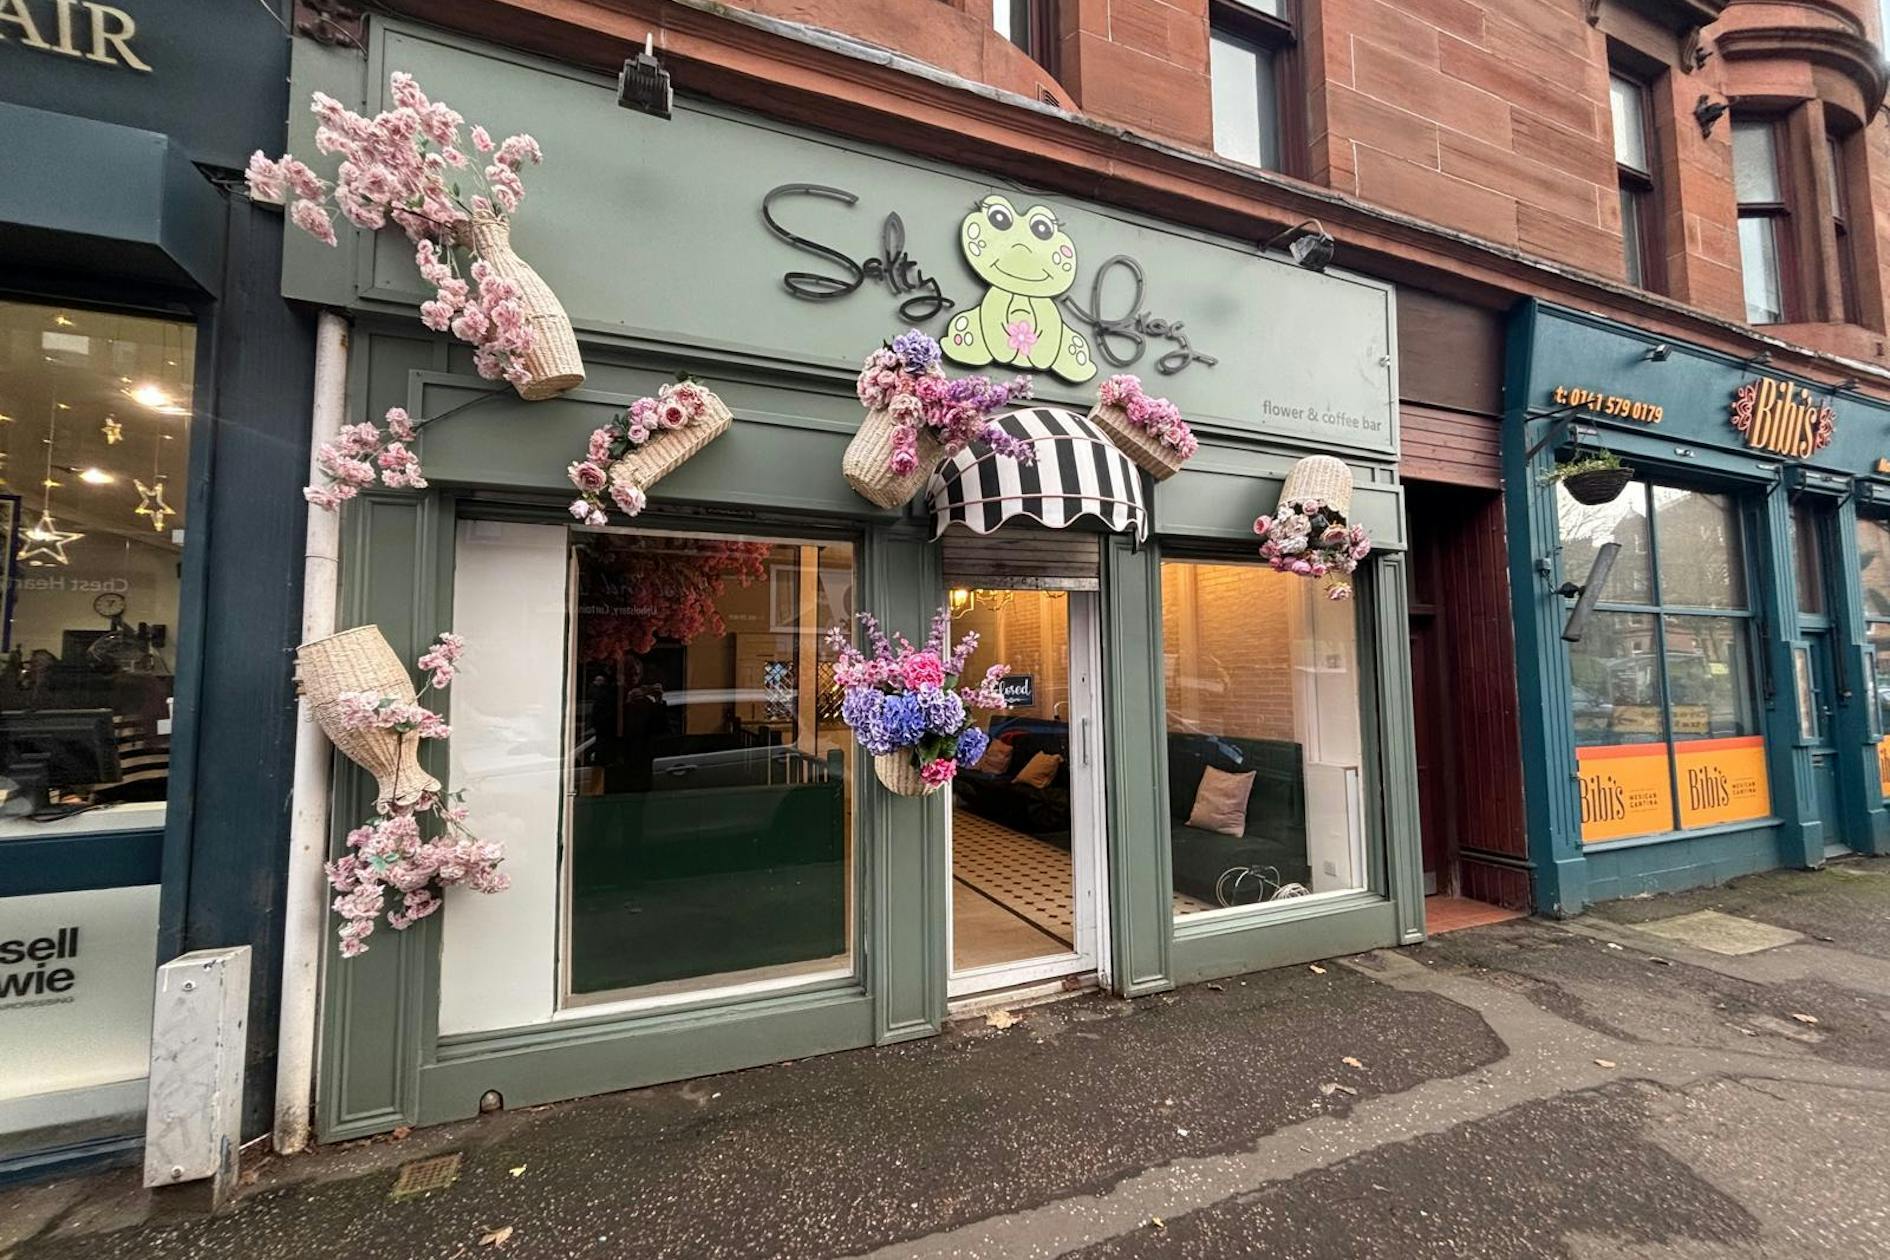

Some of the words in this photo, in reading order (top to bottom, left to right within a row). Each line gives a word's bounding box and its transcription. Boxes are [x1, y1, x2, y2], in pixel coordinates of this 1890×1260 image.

[762, 183, 955, 322] Salty
[1061, 254, 1218, 375] Frog
[1262, 400, 1304, 419] flower
[1307, 407, 1319, 421] &
[1321, 412, 1360, 428] coffee
[1362, 416, 1382, 431] bar
[1555, 386, 1568, 404] t:
[1570, 388, 1603, 411] 0141
[1605, 396, 1632, 417] 579
[1632, 402, 1663, 423] 0179
[1750, 377, 1818, 459] Bibi's
[1579, 775, 1625, 823] Bibi's
[1687, 766, 1730, 811] Bibi's
